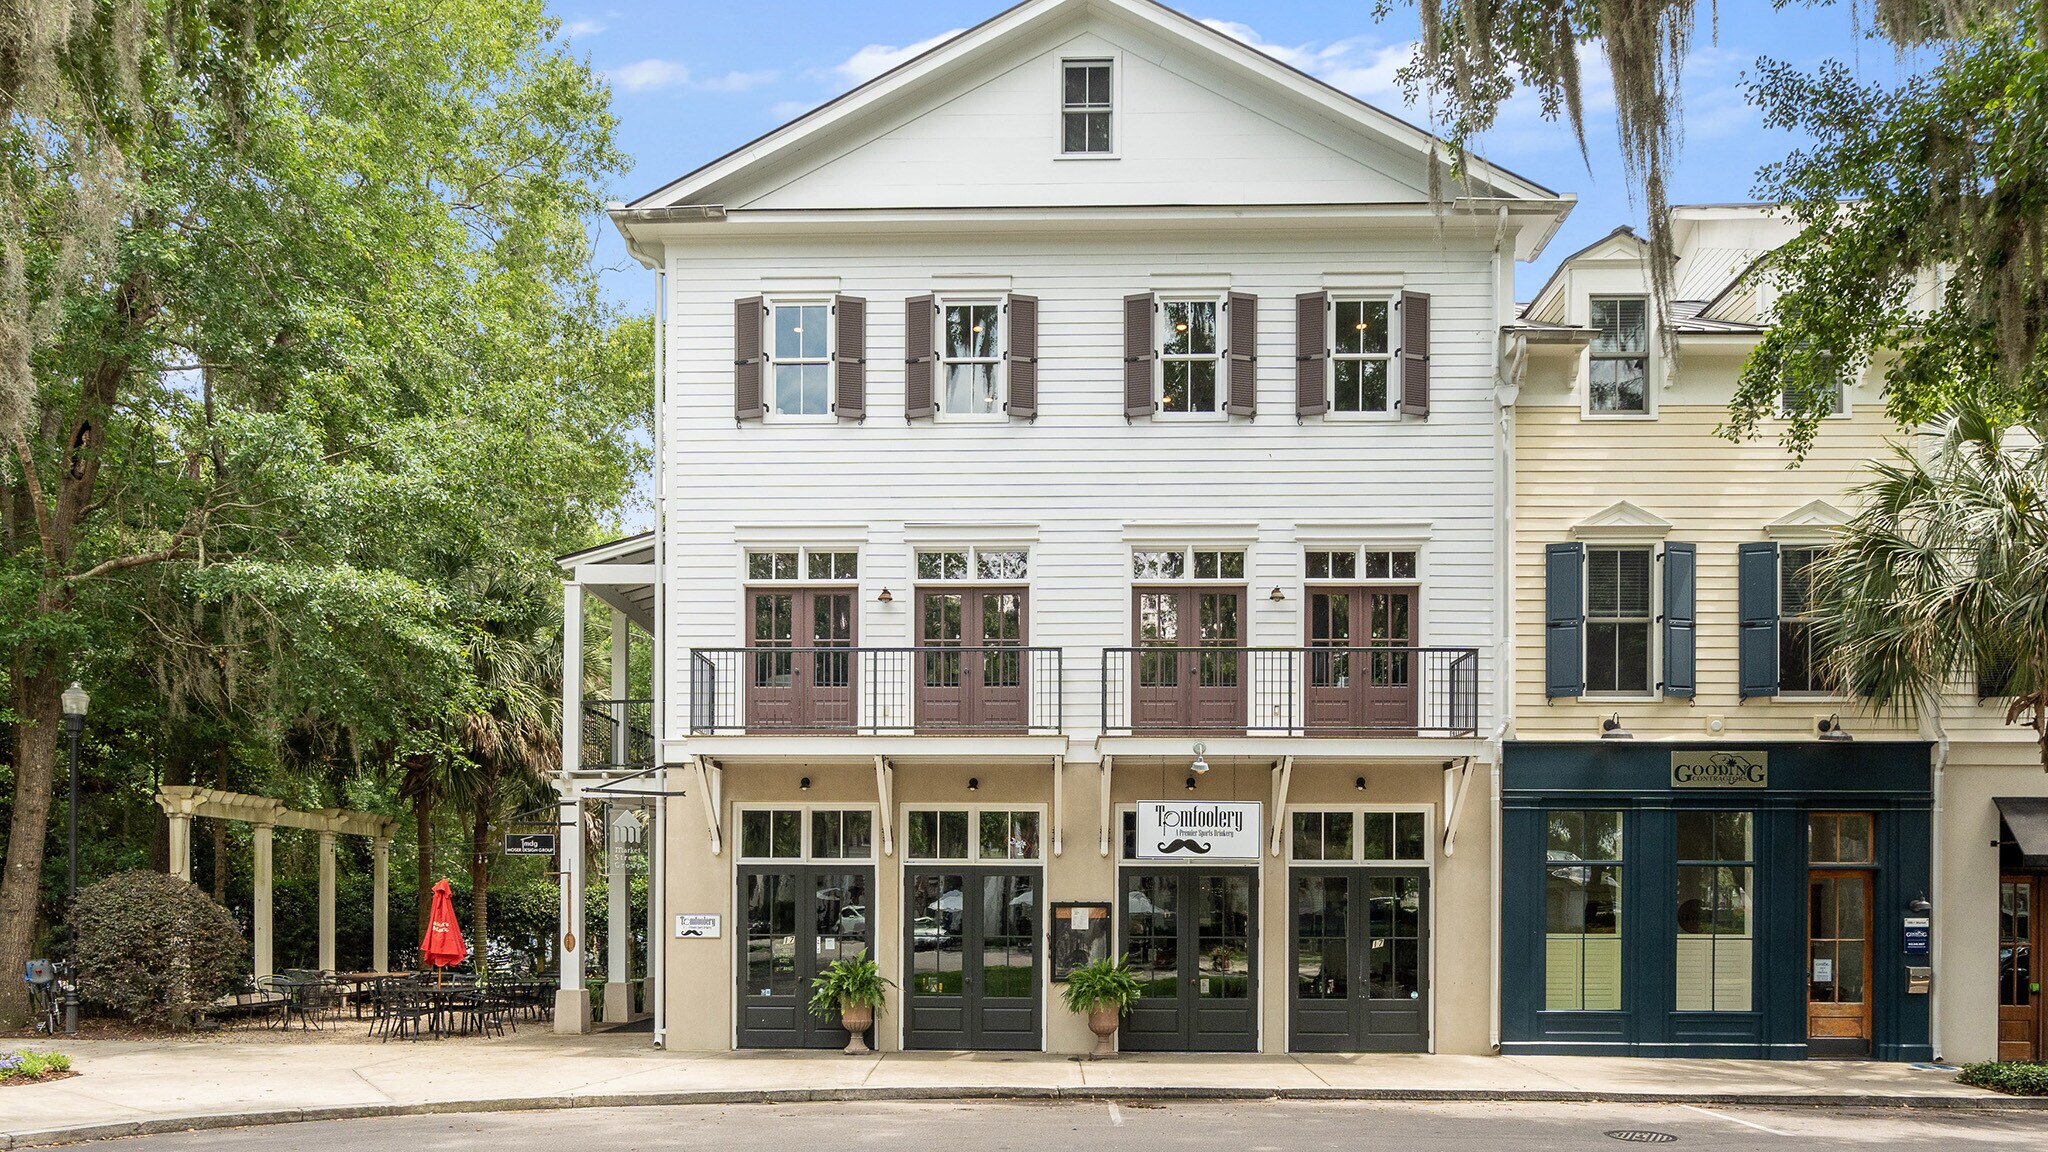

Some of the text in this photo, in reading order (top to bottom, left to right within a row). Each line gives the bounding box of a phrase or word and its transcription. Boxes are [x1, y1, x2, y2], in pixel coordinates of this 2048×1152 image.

[1674, 764, 1765, 782] GOODING
[1155, 805, 1243, 832] Tomfoolery
[524, 840, 538, 848] mdg
[614, 862, 642, 870] Group
